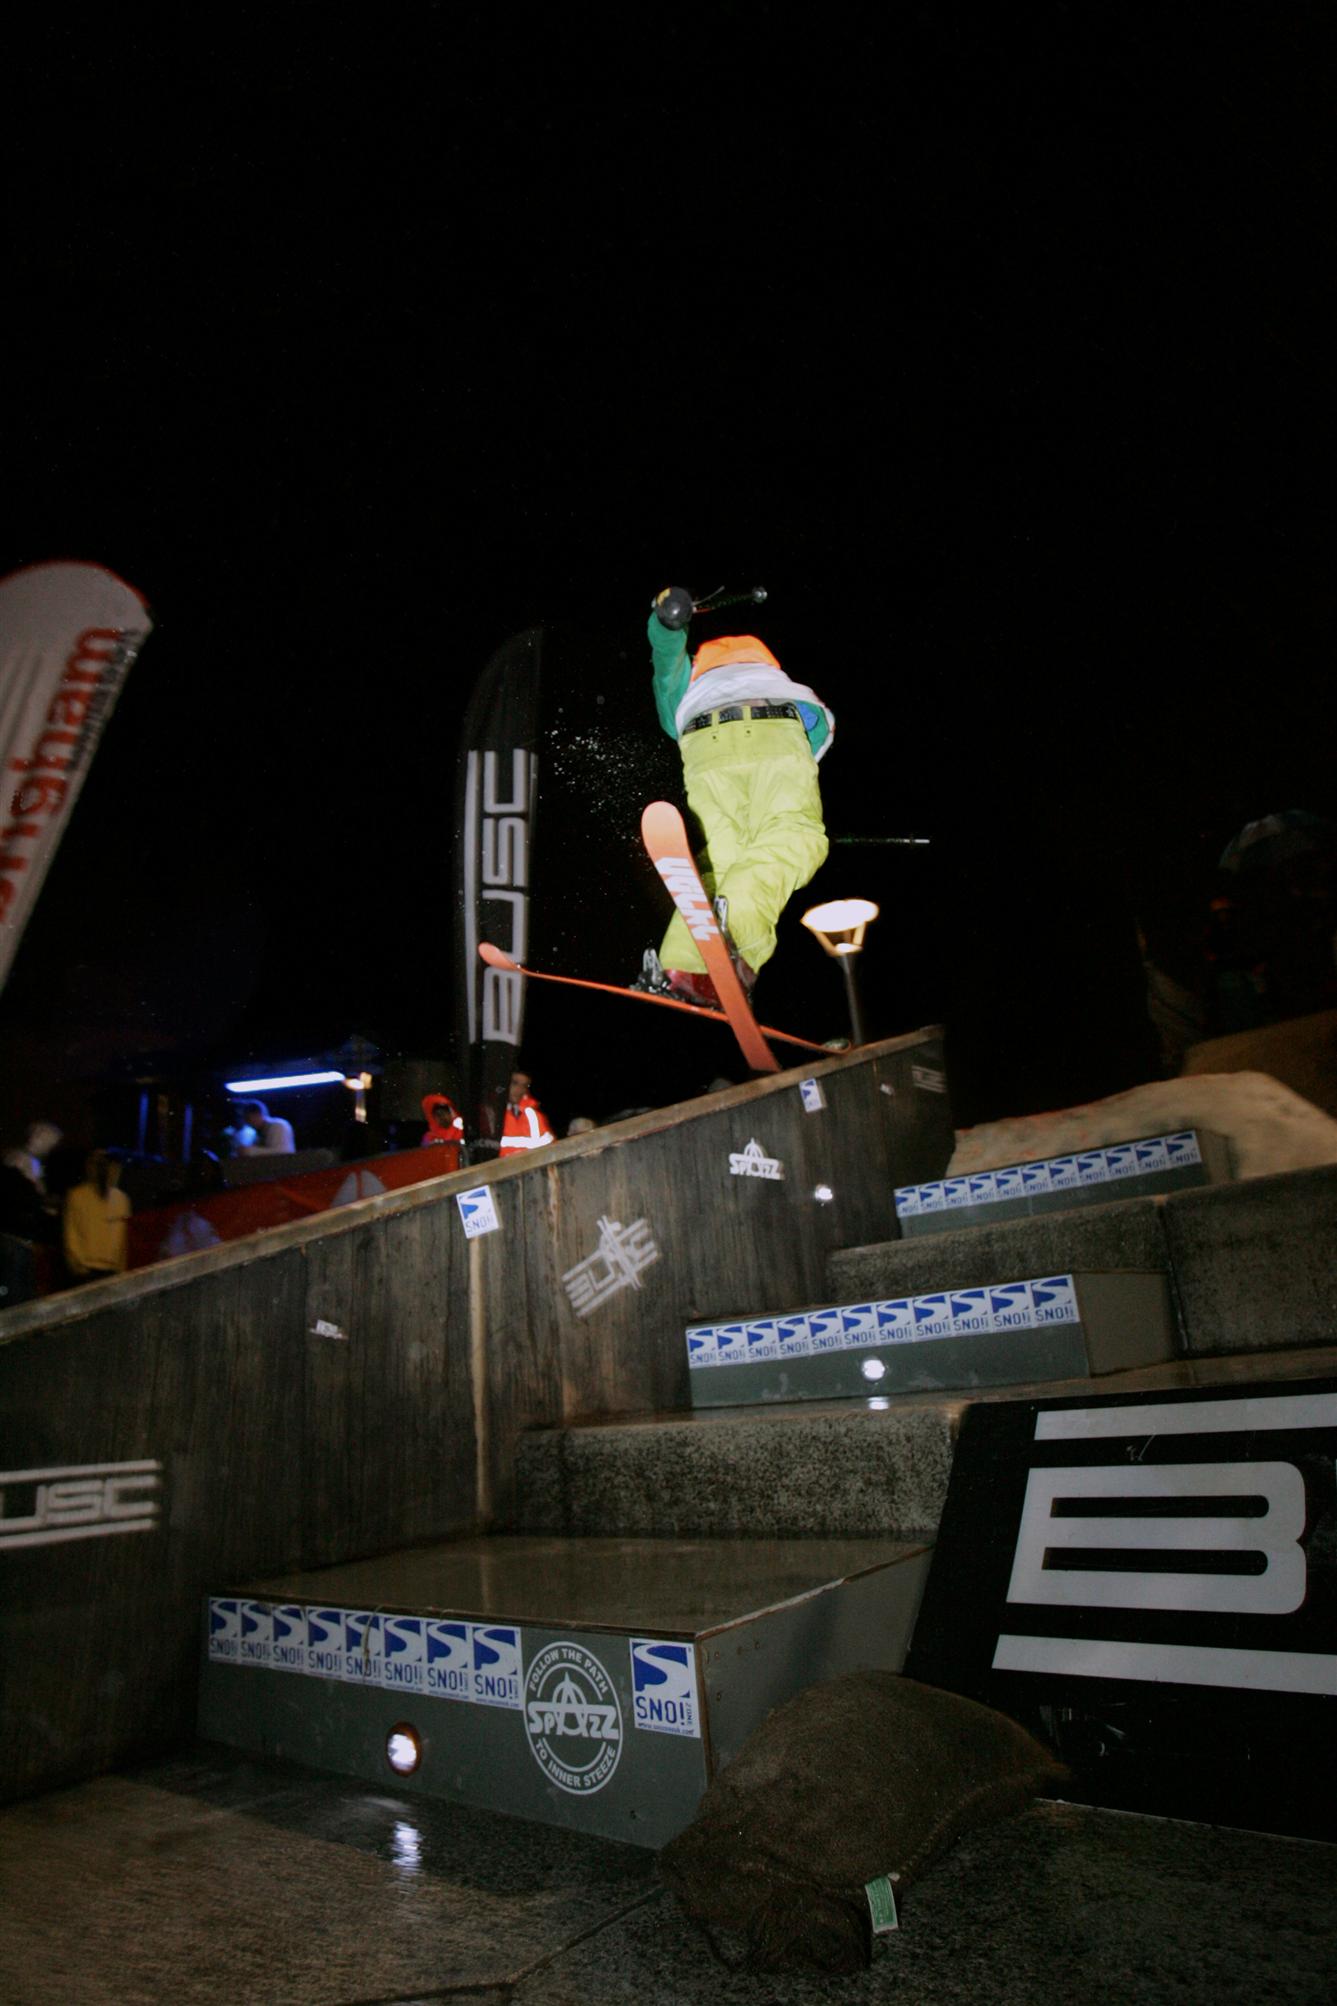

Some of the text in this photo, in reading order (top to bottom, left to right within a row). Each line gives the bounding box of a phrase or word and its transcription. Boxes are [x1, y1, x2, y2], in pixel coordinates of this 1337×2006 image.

[481, 748, 531, 1046] BUSC
[1006, 1459, 1337, 1616] B
[385, 1661, 418, 1685] SNO!
[427, 1667, 463, 1691] SNO!
[474, 1674, 512, 1699] SNO!
[529, 1649, 560, 1692] FOLLOW
[561, 1648, 582, 1664] THE
[583, 1658, 609, 1694] PATH
[635, 1696, 685, 1726] SNO!
[535, 1739, 616, 1788] TO INNER STEEZE
